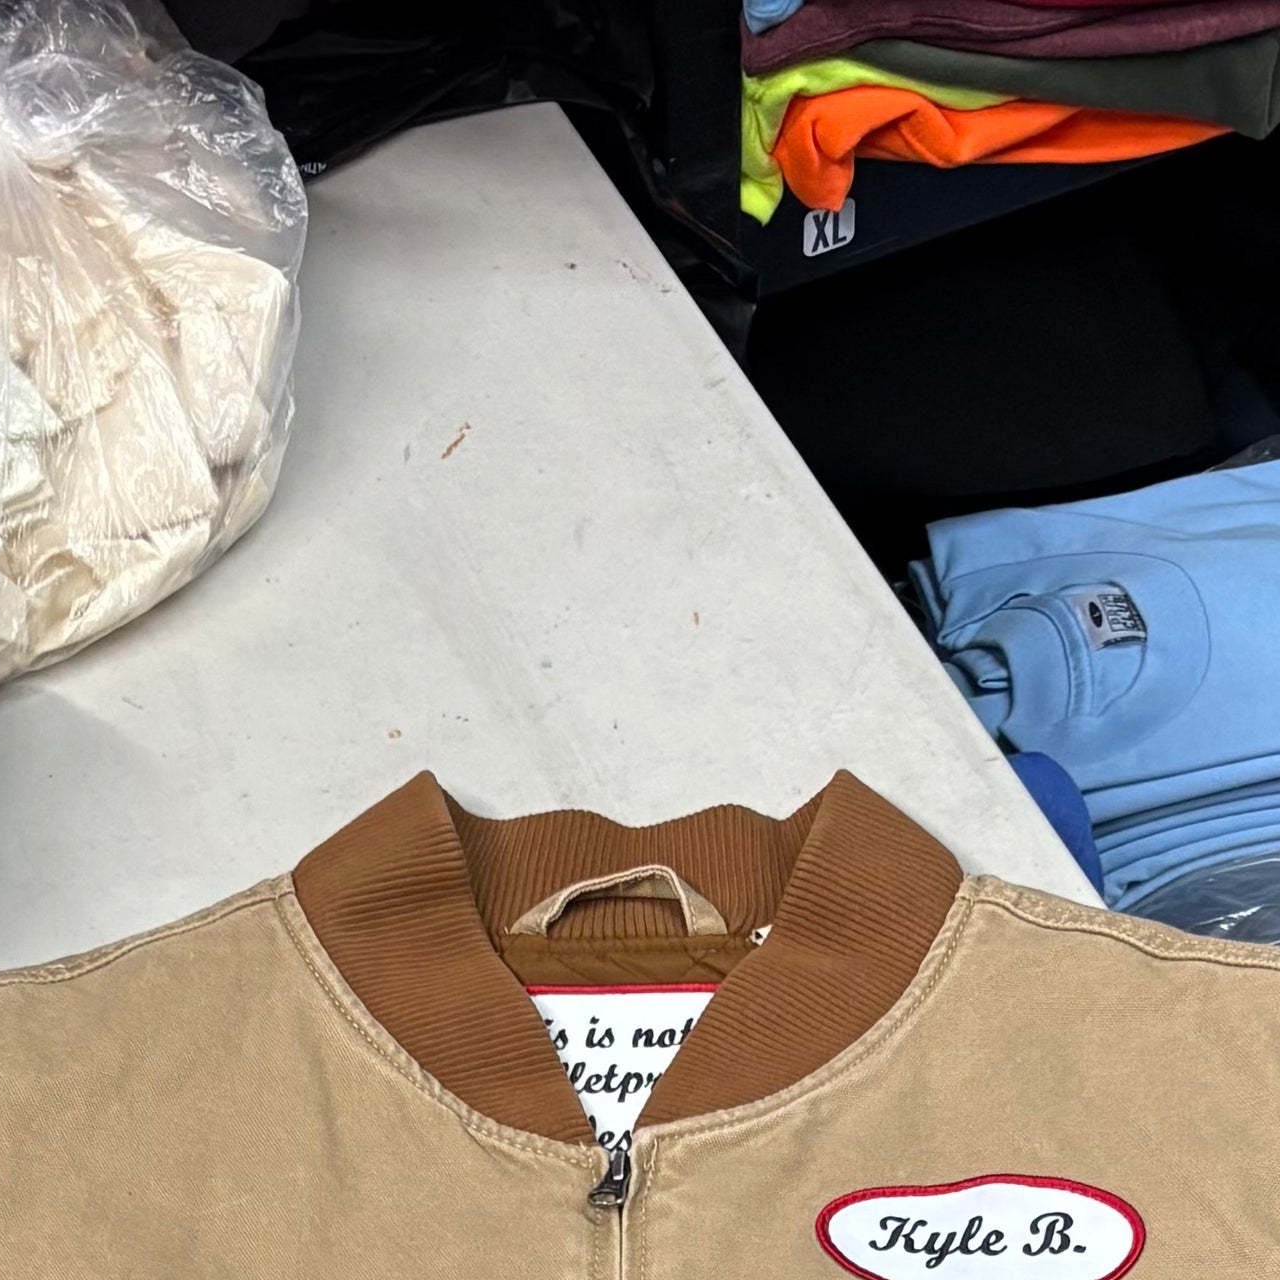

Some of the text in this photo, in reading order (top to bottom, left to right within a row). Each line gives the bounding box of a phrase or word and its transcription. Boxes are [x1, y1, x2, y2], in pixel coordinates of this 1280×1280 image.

[811, 210, 847, 253] XL
[585, 1016, 615, 1048] is
[632, 1018, 694, 1048] not
[868, 1212, 1087, 1269] Kyle B.
